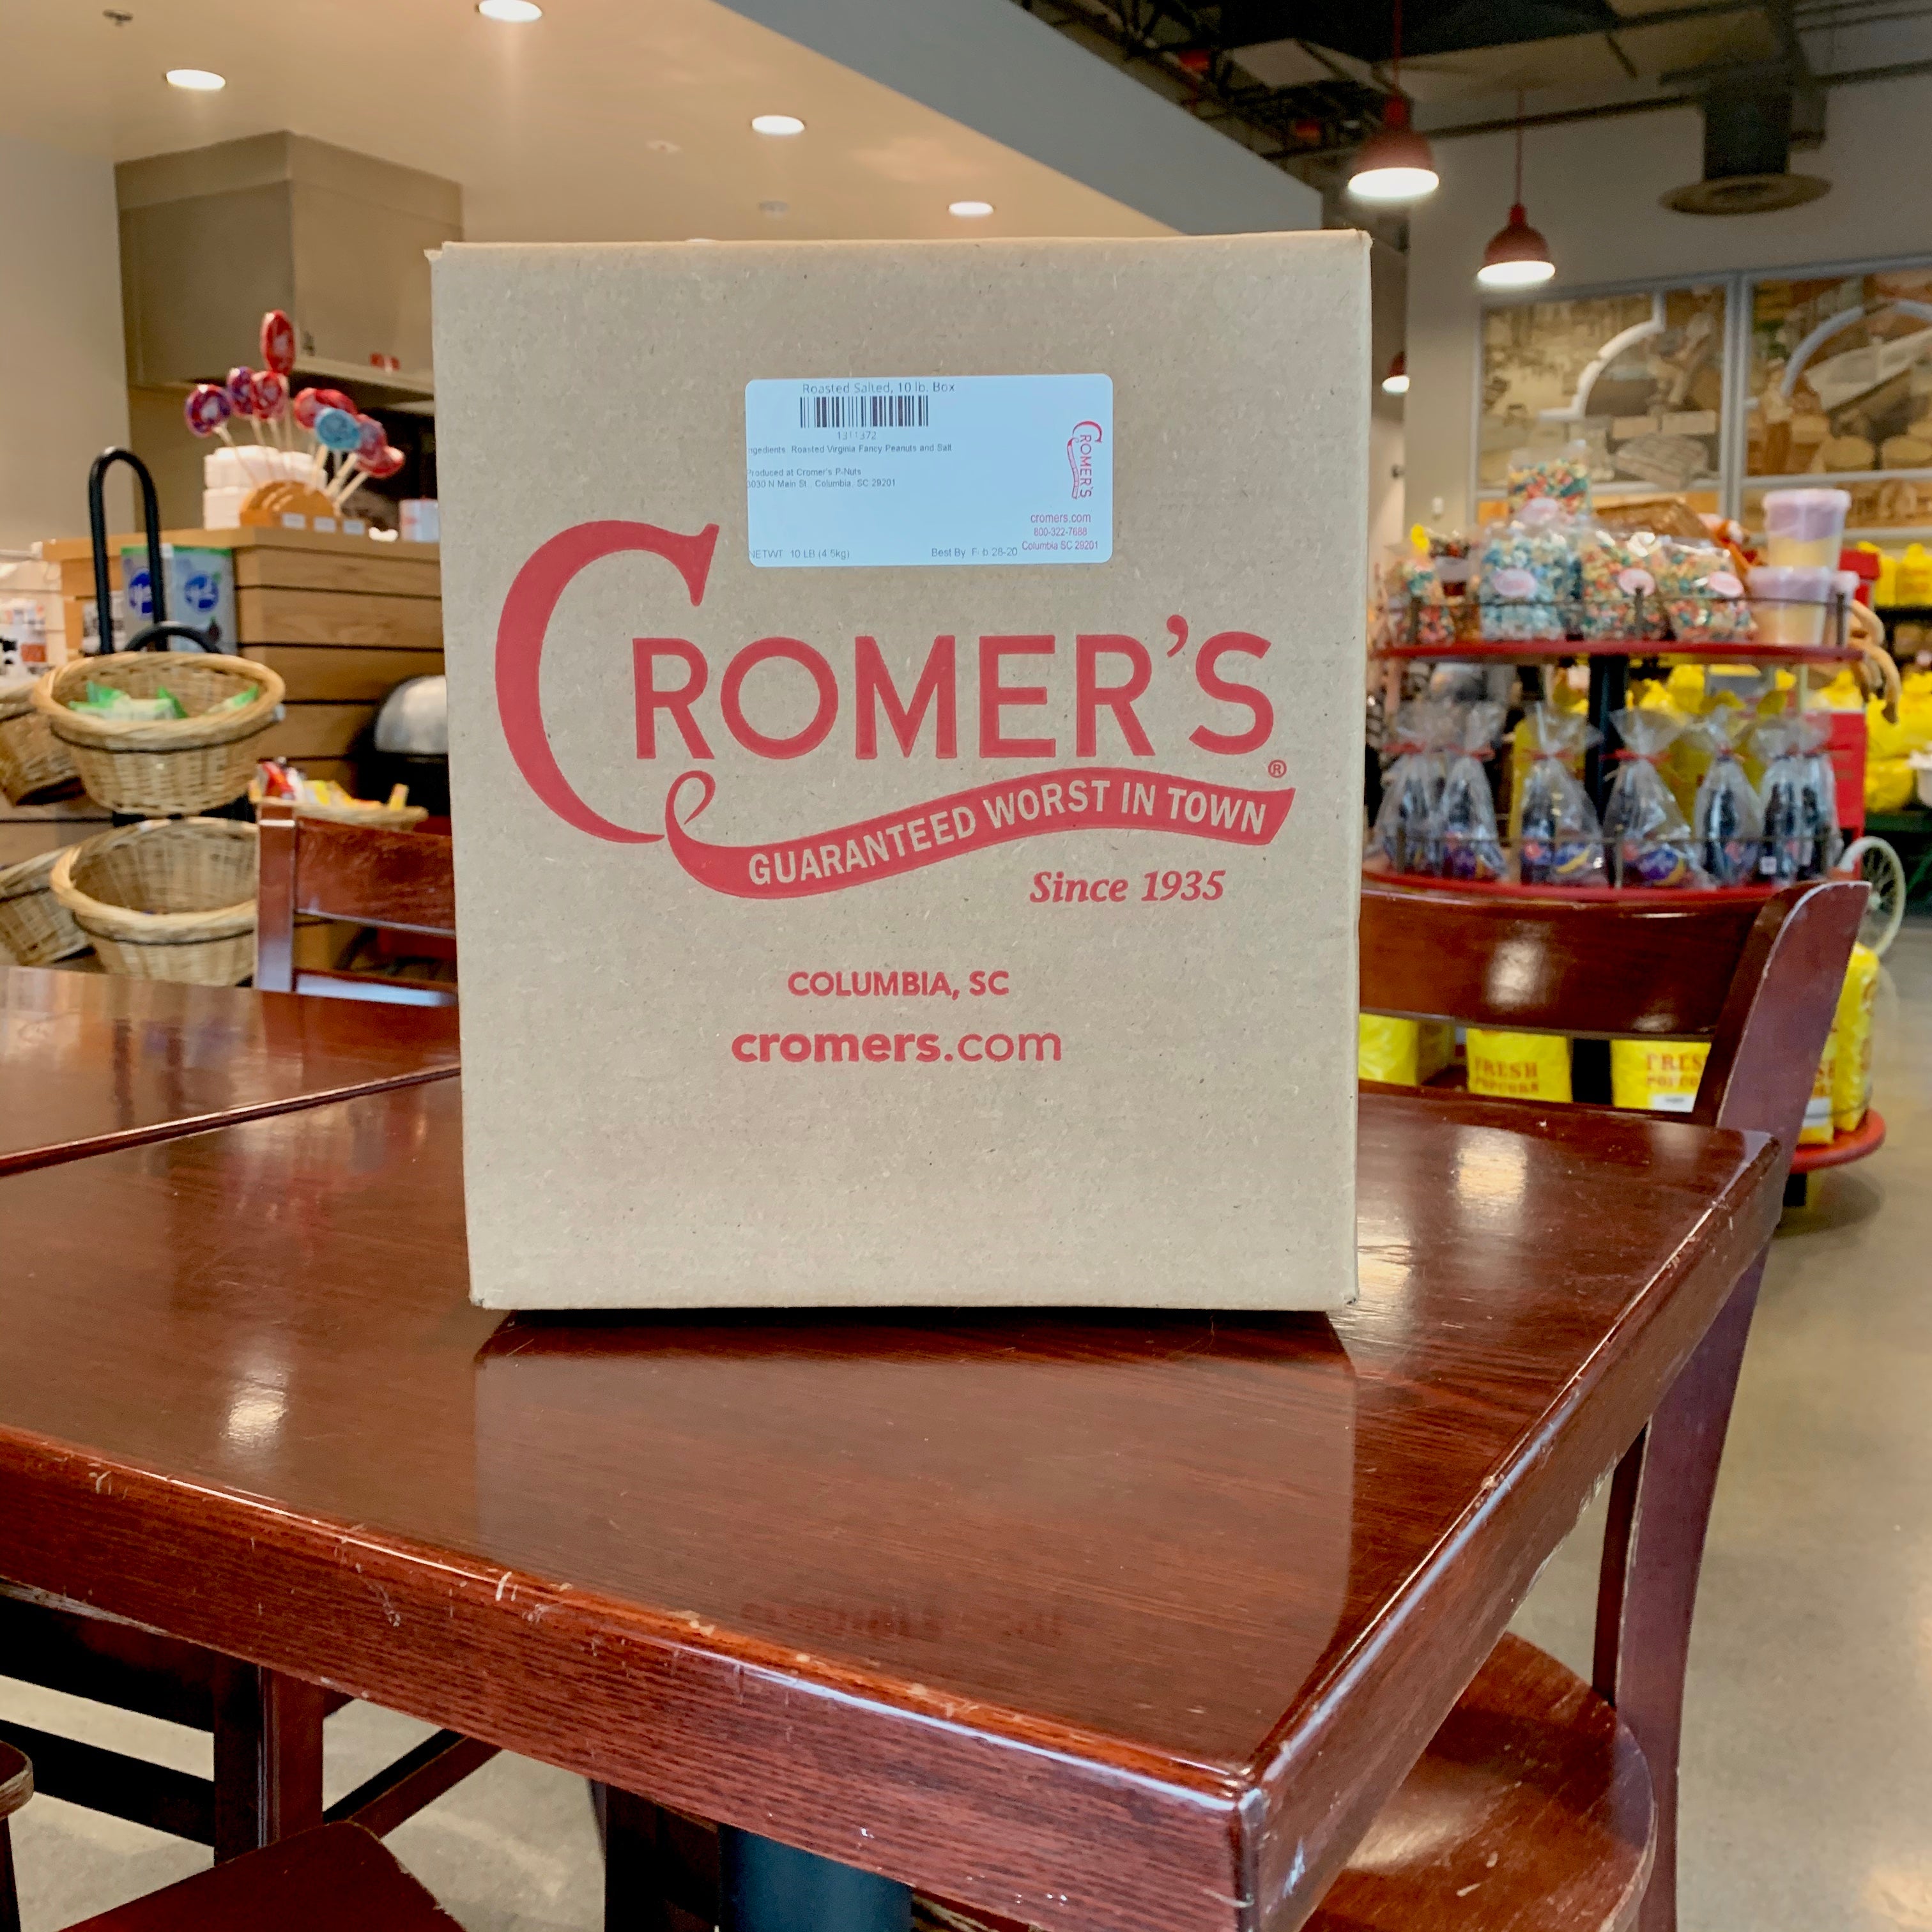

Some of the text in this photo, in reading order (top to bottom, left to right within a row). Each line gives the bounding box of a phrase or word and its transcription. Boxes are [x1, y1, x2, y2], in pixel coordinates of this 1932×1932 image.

[802, 381, 955, 394] Roasted Salted, 10 lb. Box
[792, 445, 824, 454] Roasted
[827, 445, 855, 455] Virginia
[859, 444, 882, 454] Fancy
[885, 444, 917, 452] Peanuts
[920, 443, 934, 452] and
[937, 443, 952, 452] Salt
[1072, 420, 1103, 498] CROMER'S
[797, 468, 832, 477] Cromer's
[857, 479, 869, 487] SC
[871, 479, 896, 487] 29201
[1031, 513, 1091, 523] cromers.com
[1034, 526, 1087, 537] 800-322-7688
[1022, 540, 1098, 550] Columbia SC 29201
[790, 549, 801, 558] 10
[803, 549, 815, 558] LB
[931, 546, 1018, 559] Best By Fb 28-20
[495, 520, 1273, 843] CROMER'S
[749, 779, 1266, 885] GUARANTEED WORST IN TOWN
[1029, 870, 1226, 903] Since 1935
[788, 970, 1009, 1000] COLUMBIA, SC
[731, 1032, 1061, 1062] cromers.com
[1475, 1055, 1538, 1079] FRESH
[1646, 1052, 1706, 1071] FRES
